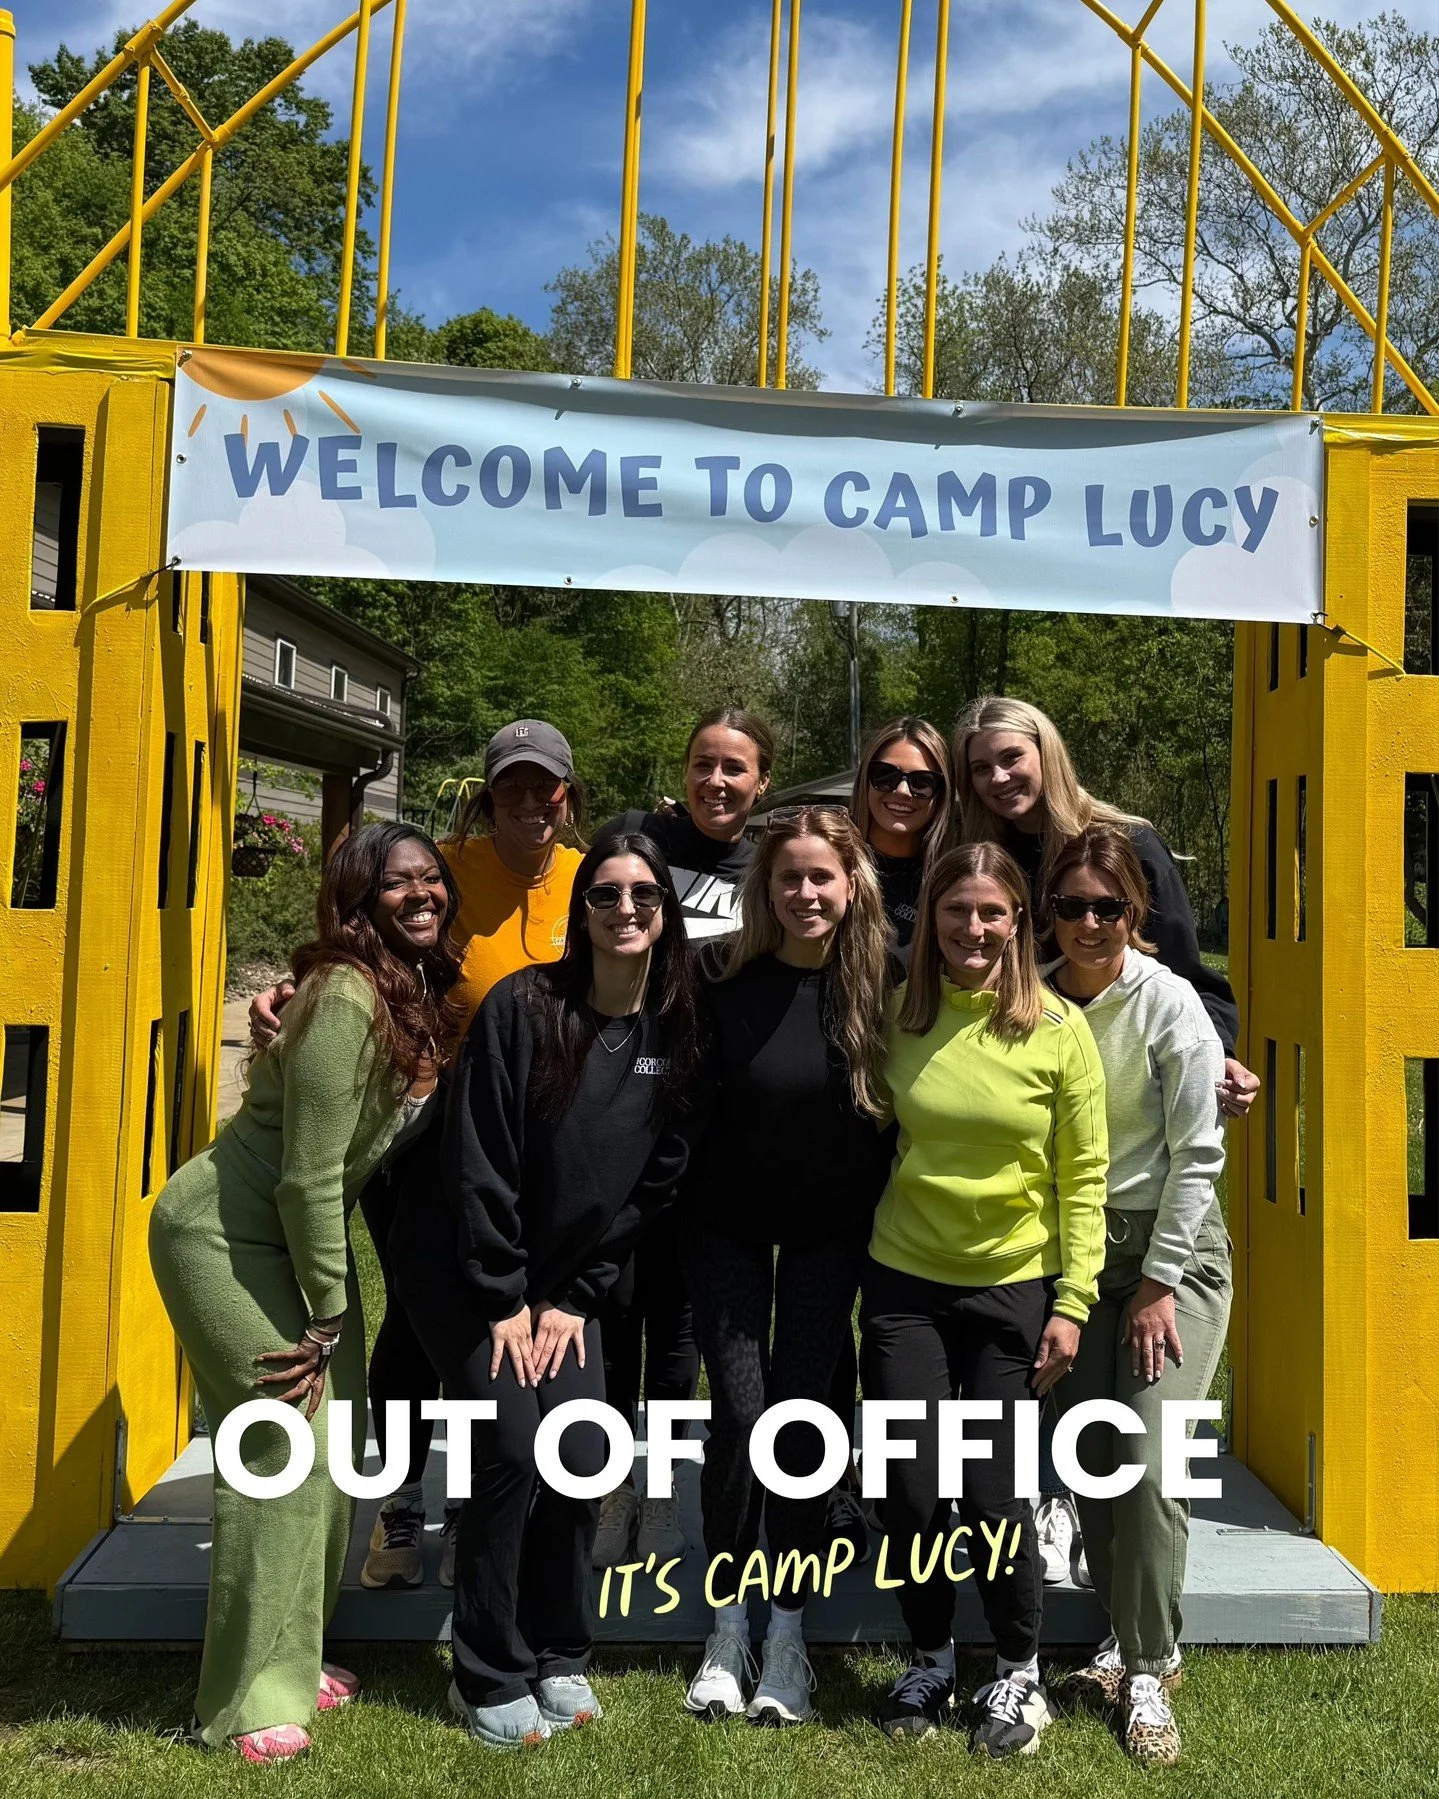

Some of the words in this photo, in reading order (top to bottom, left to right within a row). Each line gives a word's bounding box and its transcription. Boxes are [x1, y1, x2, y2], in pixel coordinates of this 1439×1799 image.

[224, 433, 663, 518] WELCOME
[695, 455, 792, 524] TO
[824, 470, 1051, 540] CAMP
[1085, 484, 1279, 553] LUCY
